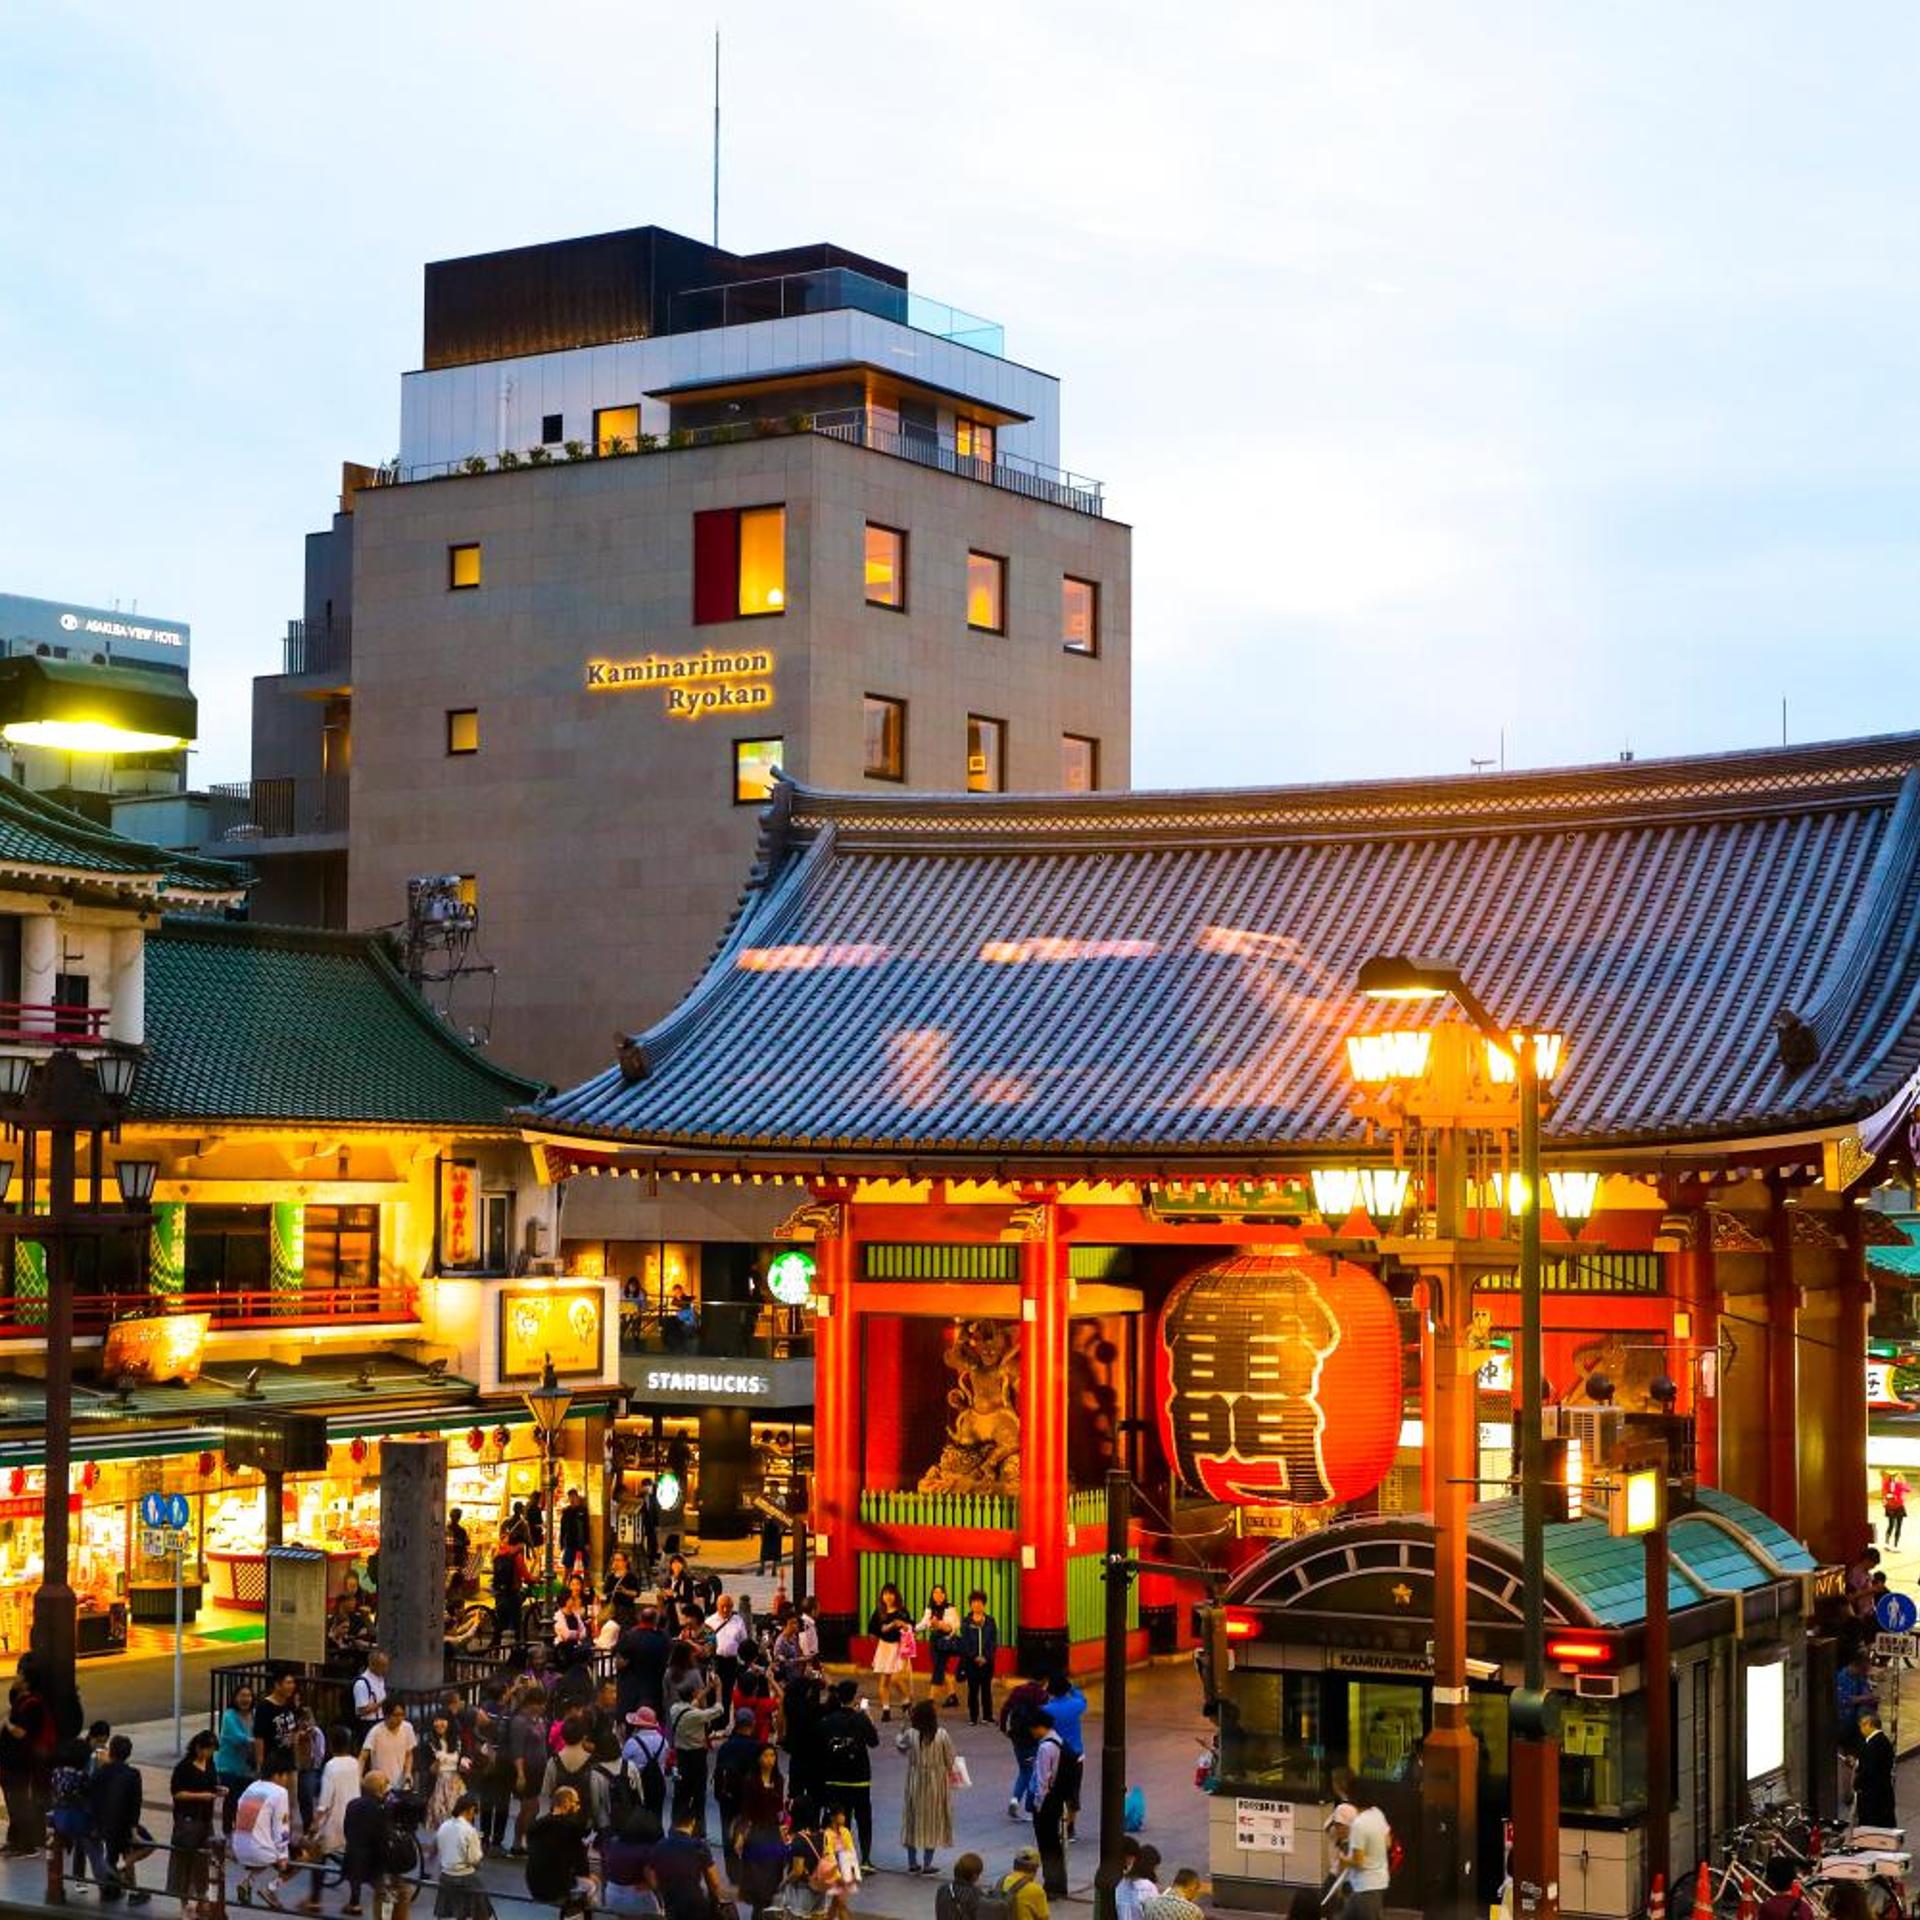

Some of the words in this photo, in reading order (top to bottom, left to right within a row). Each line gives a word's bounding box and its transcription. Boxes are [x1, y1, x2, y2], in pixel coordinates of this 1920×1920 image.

[127, 626, 153, 641] VIEW
[155, 631, 181, 646] HOTEL
[586, 652, 768, 685] Kaminarimon
[668, 684, 767, 713] Ryokan
[647, 1371, 762, 1394] STARBUCKS
